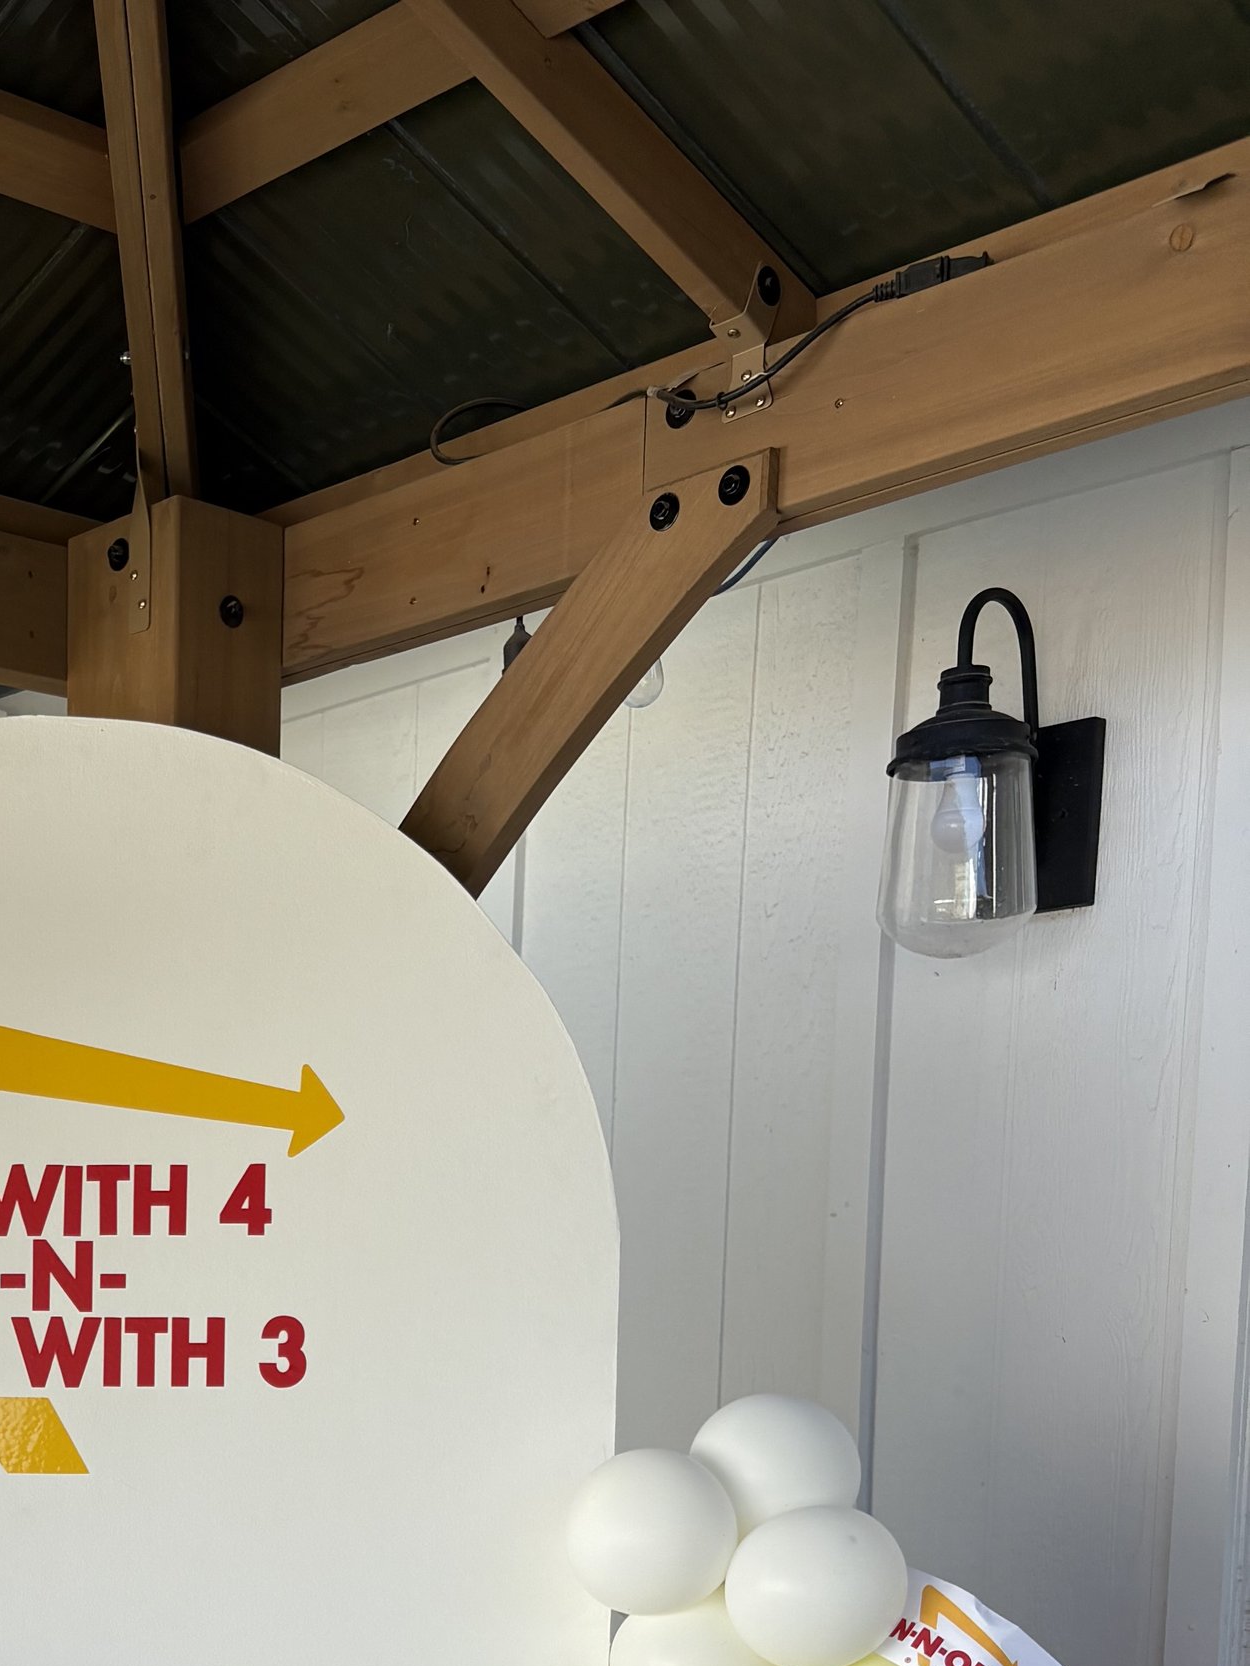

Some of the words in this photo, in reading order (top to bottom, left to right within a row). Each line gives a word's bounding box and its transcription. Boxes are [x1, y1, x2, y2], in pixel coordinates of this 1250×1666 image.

[218, 1162, 273, 1237] 4
[0, 1238, 127, 1313] -N-
[10, 1316, 226, 1388] WITH
[258, 1314, 308, 1389] 3
